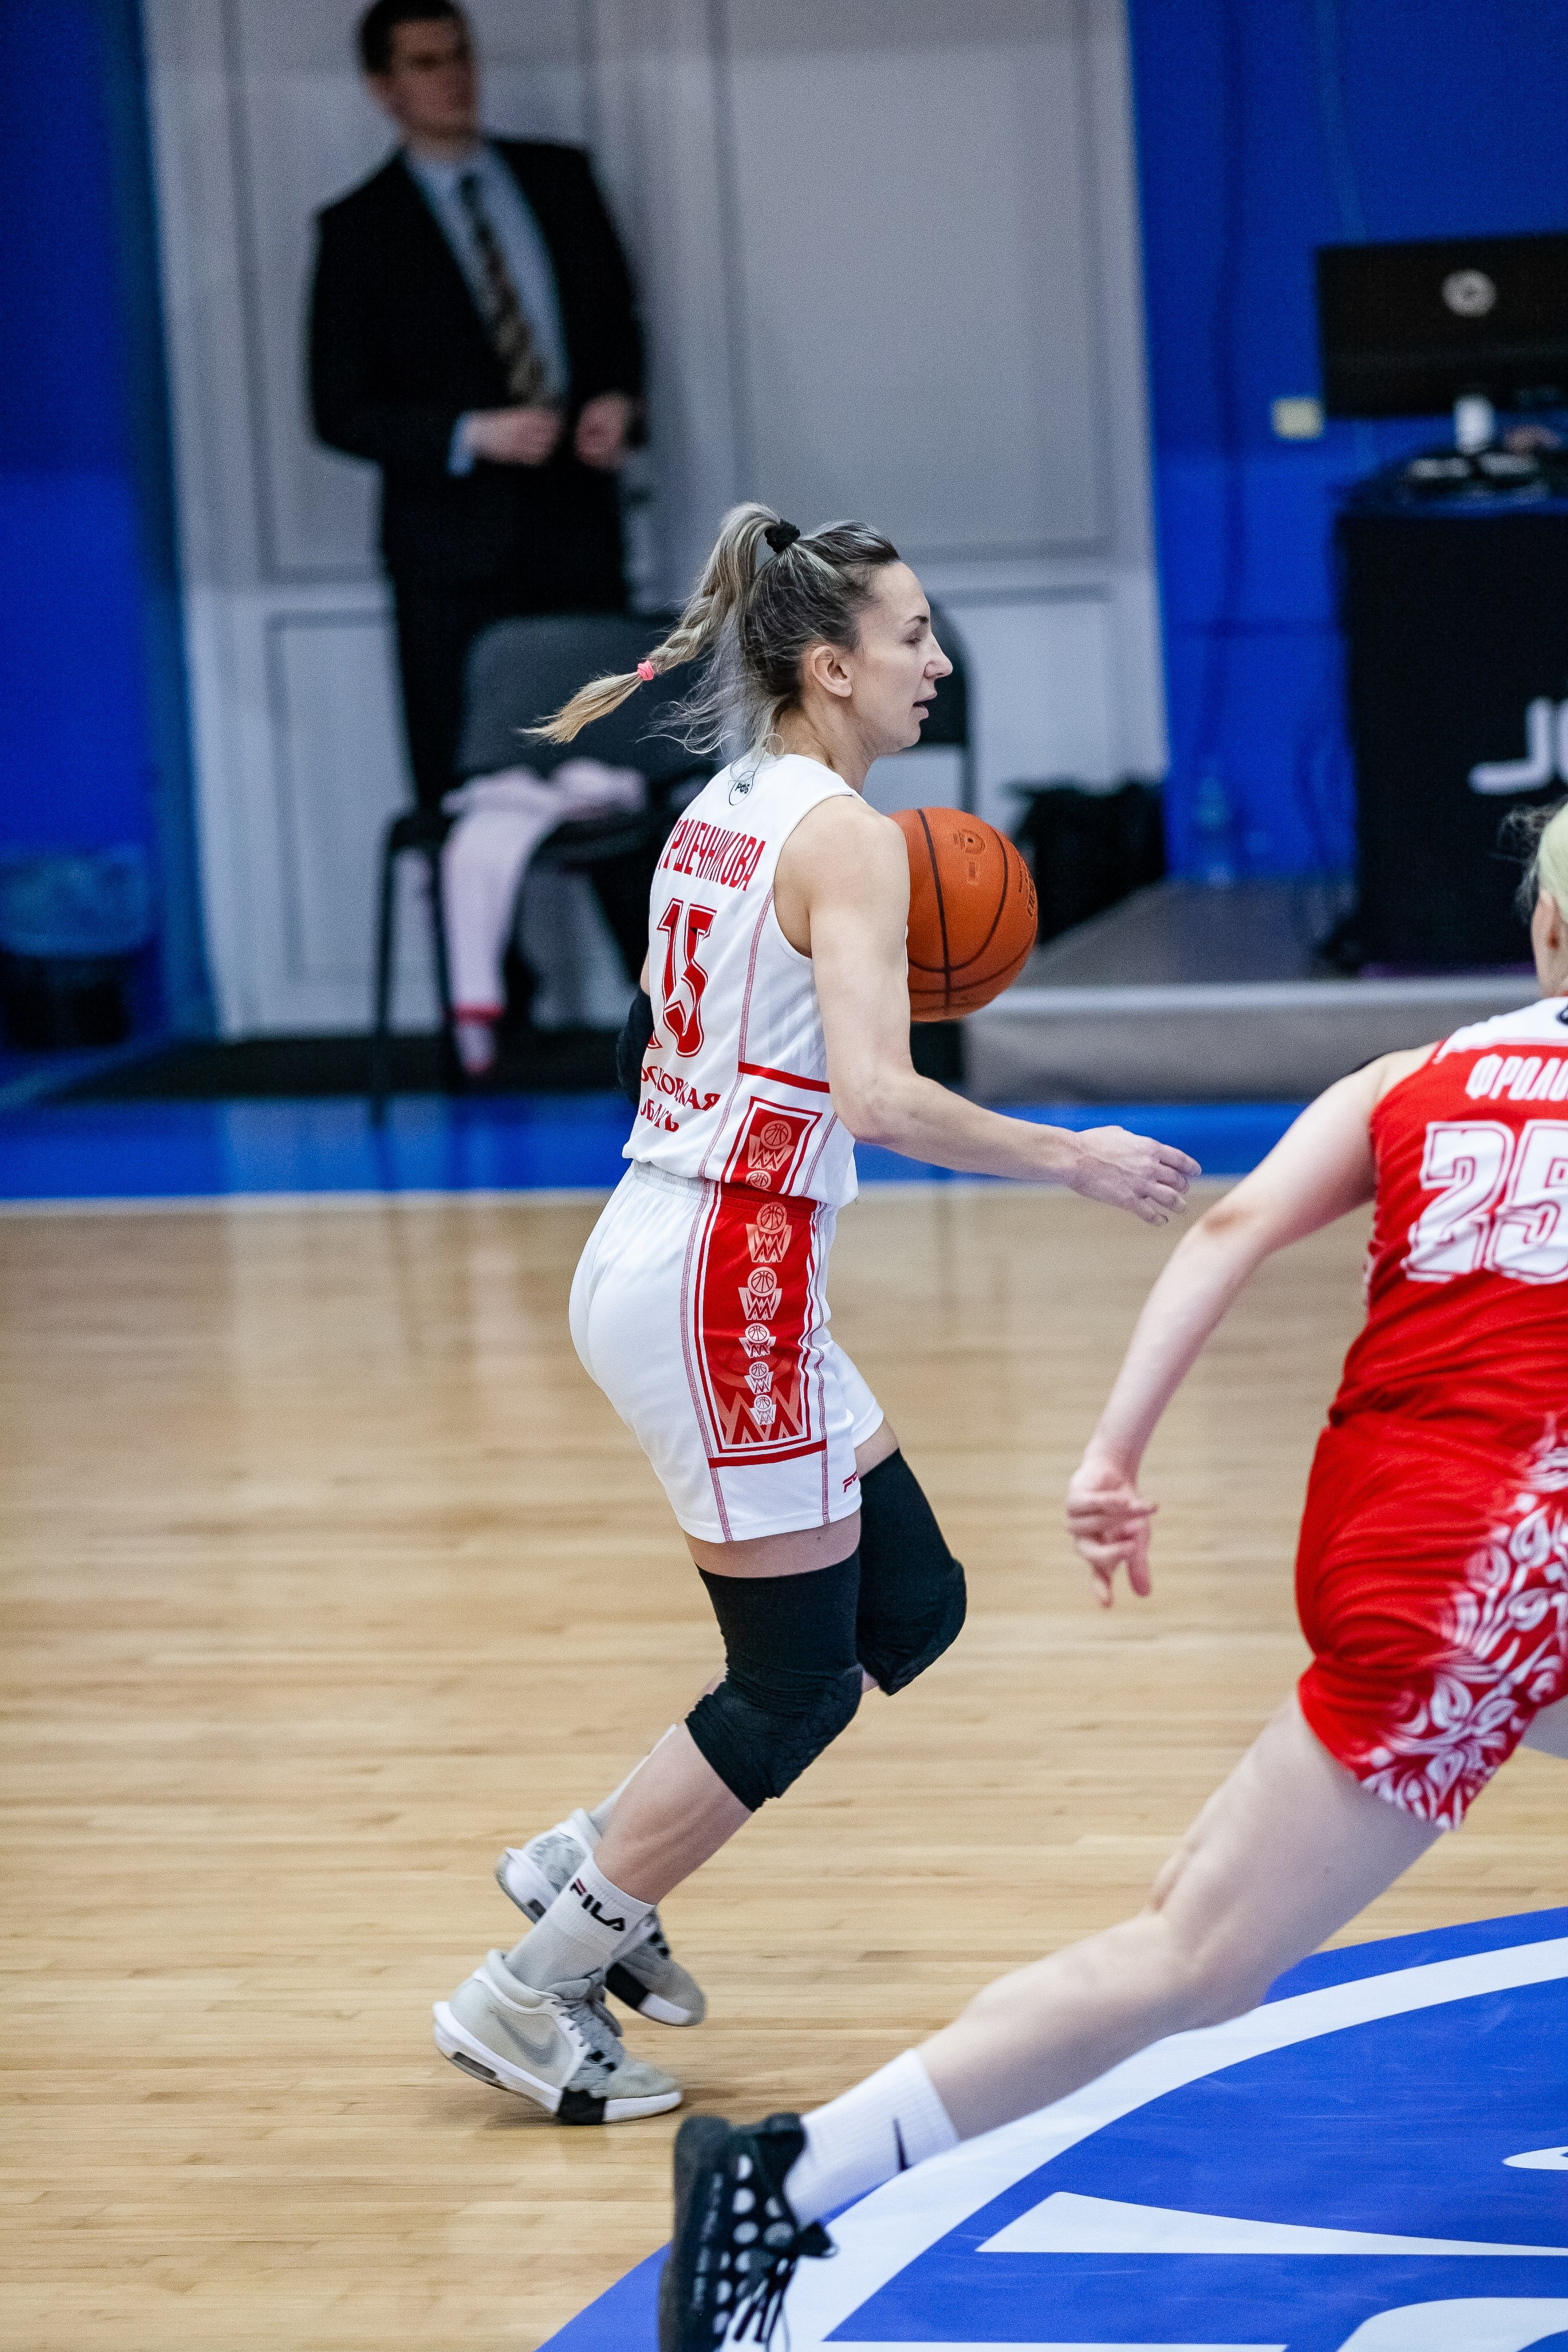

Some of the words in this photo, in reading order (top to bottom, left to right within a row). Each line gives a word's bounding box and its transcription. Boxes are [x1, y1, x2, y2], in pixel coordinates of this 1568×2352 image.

[658, 818, 766, 892] РШЕЧНИКОВА
[647, 897, 717, 1058] 15
[1401, 1119, 1568, 1286] 25
[570, 1878, 625, 1932] FILA
